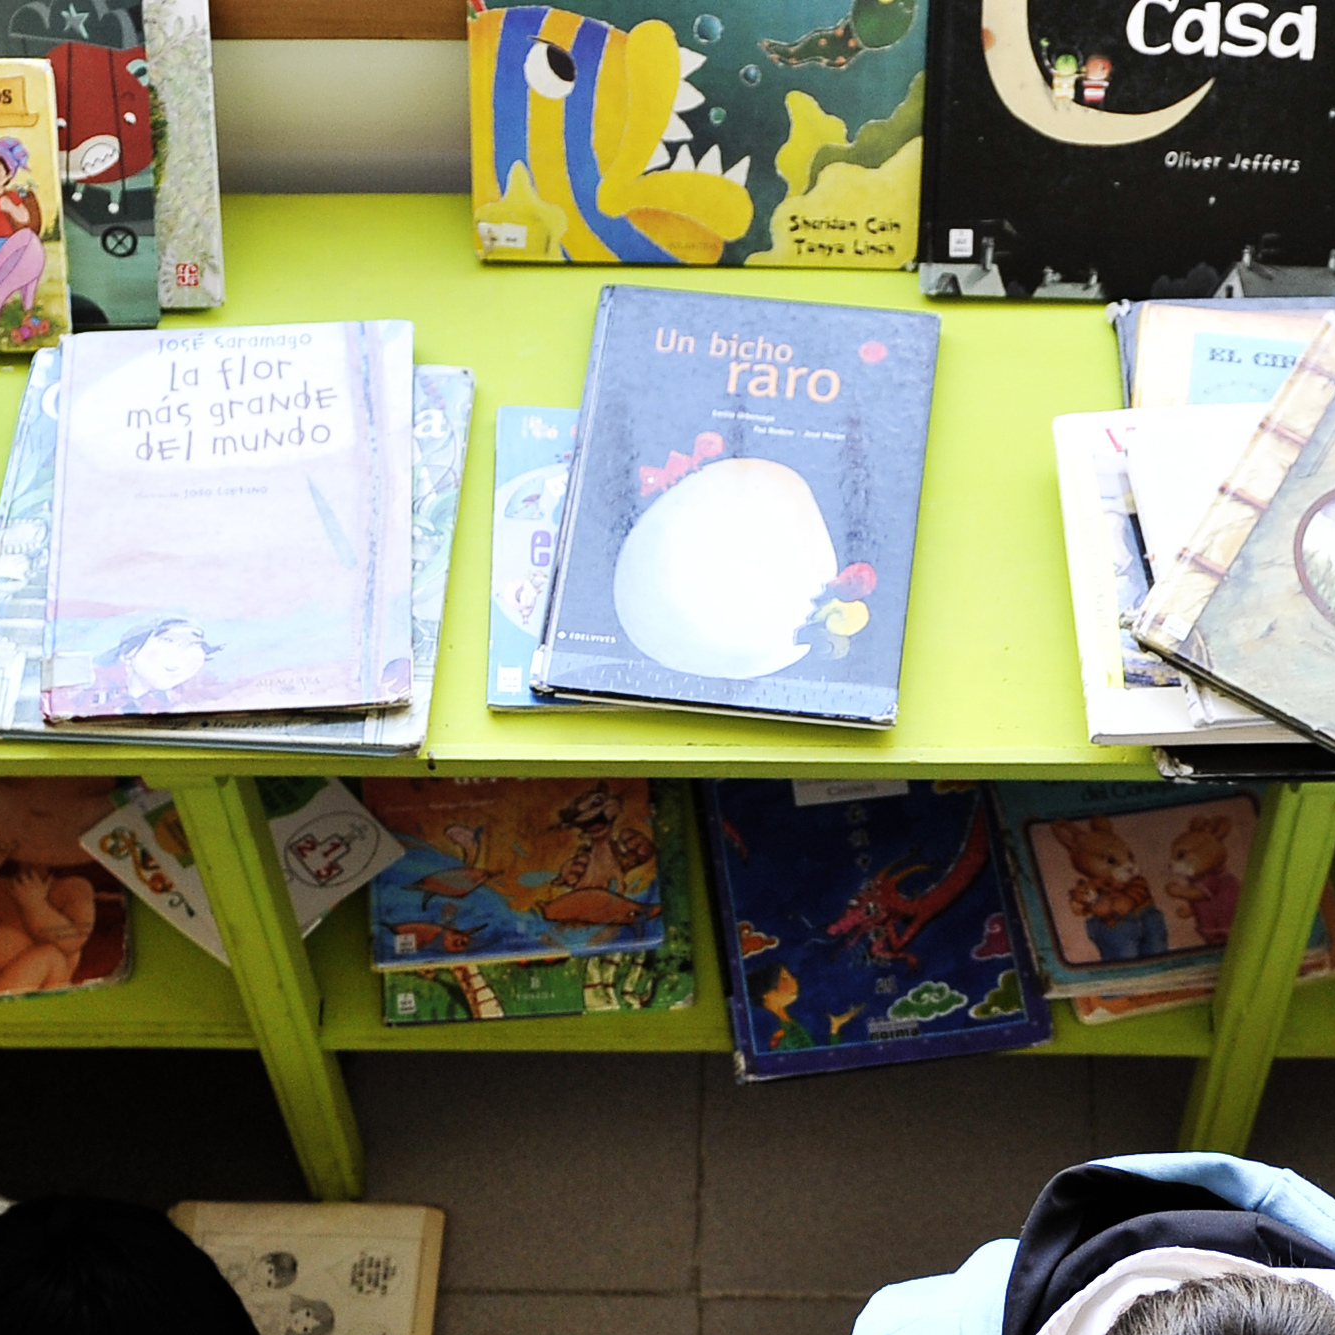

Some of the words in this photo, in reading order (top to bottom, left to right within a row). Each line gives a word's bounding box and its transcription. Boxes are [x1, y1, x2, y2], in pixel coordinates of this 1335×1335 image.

[1125, 0, 1319, 61] Casa
[1165, 150, 1222, 170] Oliver
[1227, 152, 1301, 173] Jeffers
[789, 215, 857, 234] Sheridan
[865, 216, 902, 235] Cain
[794, 238, 846, 257] Tanya
[655, 327, 696, 356] Un
[709, 331, 794, 362] bicho
[1208, 347, 1241, 364] EL
[725, 360, 843, 403] raro
